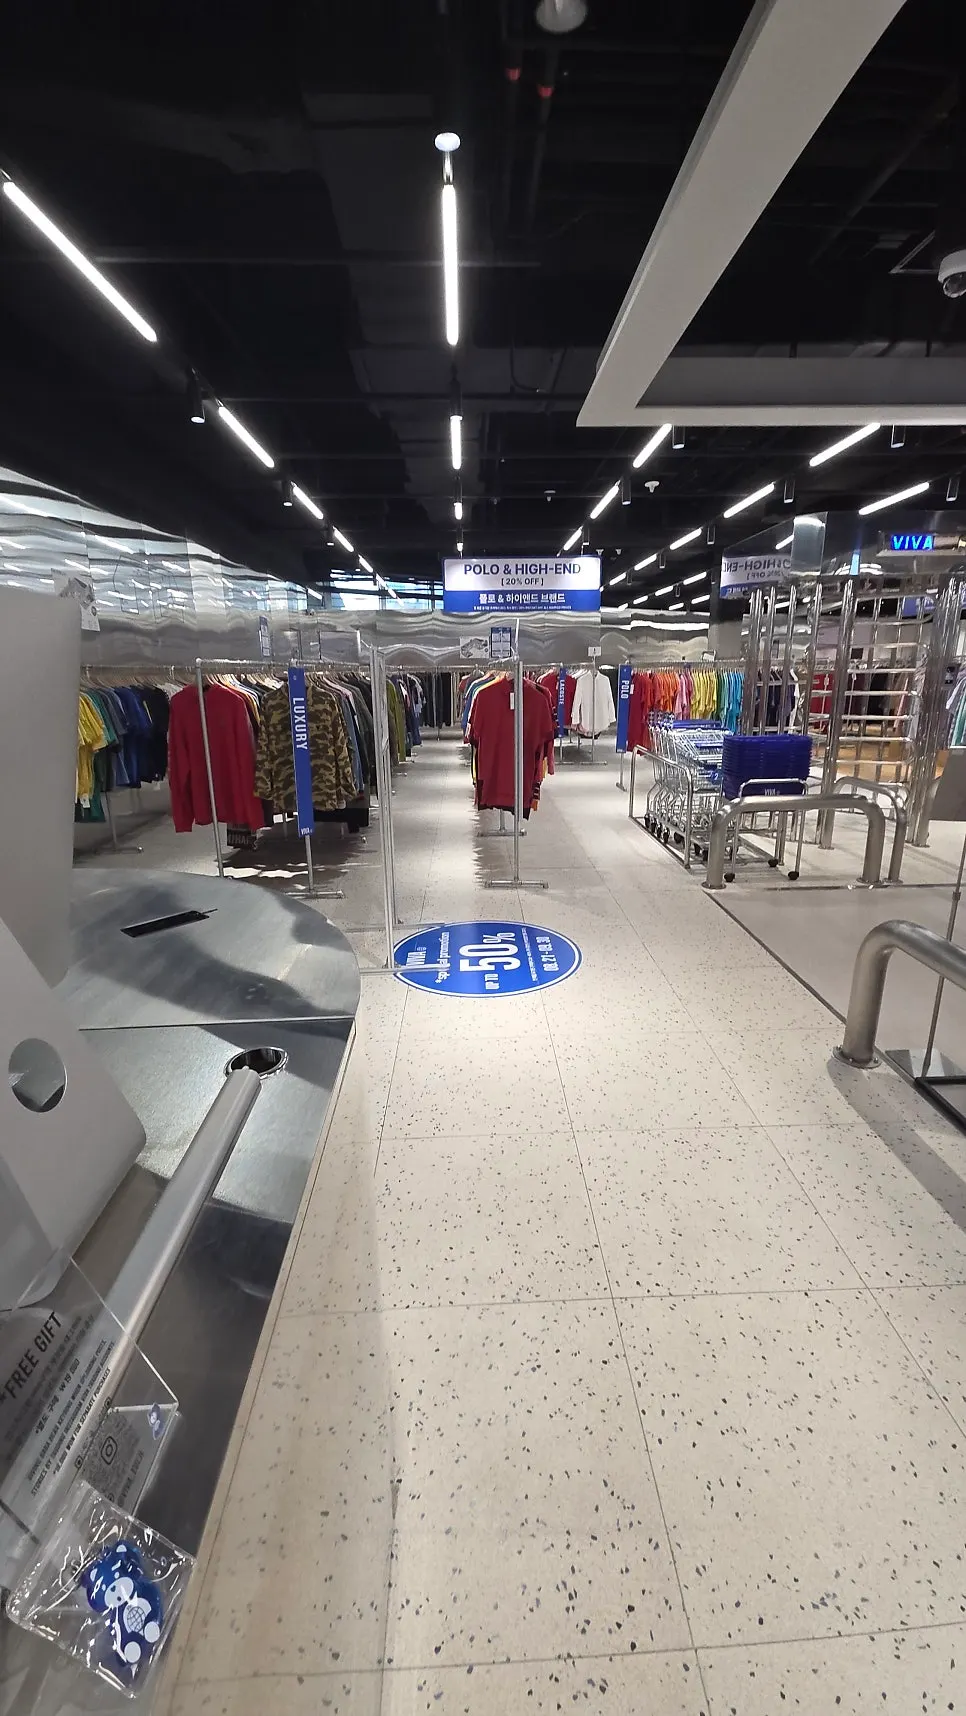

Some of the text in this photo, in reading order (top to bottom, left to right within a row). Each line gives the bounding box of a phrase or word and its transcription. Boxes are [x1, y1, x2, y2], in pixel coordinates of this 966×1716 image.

[892, 535, 933, 550] VIVA
[464, 563, 581, 575] POLO & HIGH-END
[497, 594, 505, 603] &
[540, 593, 566, 604] 브랜드
[620, 680, 630, 699] POLO
[292, 697, 308, 750] LUXURY
[33, 1311, 63, 1353] GIFT
[77, 1395, 96, 1425] SEPARATE
